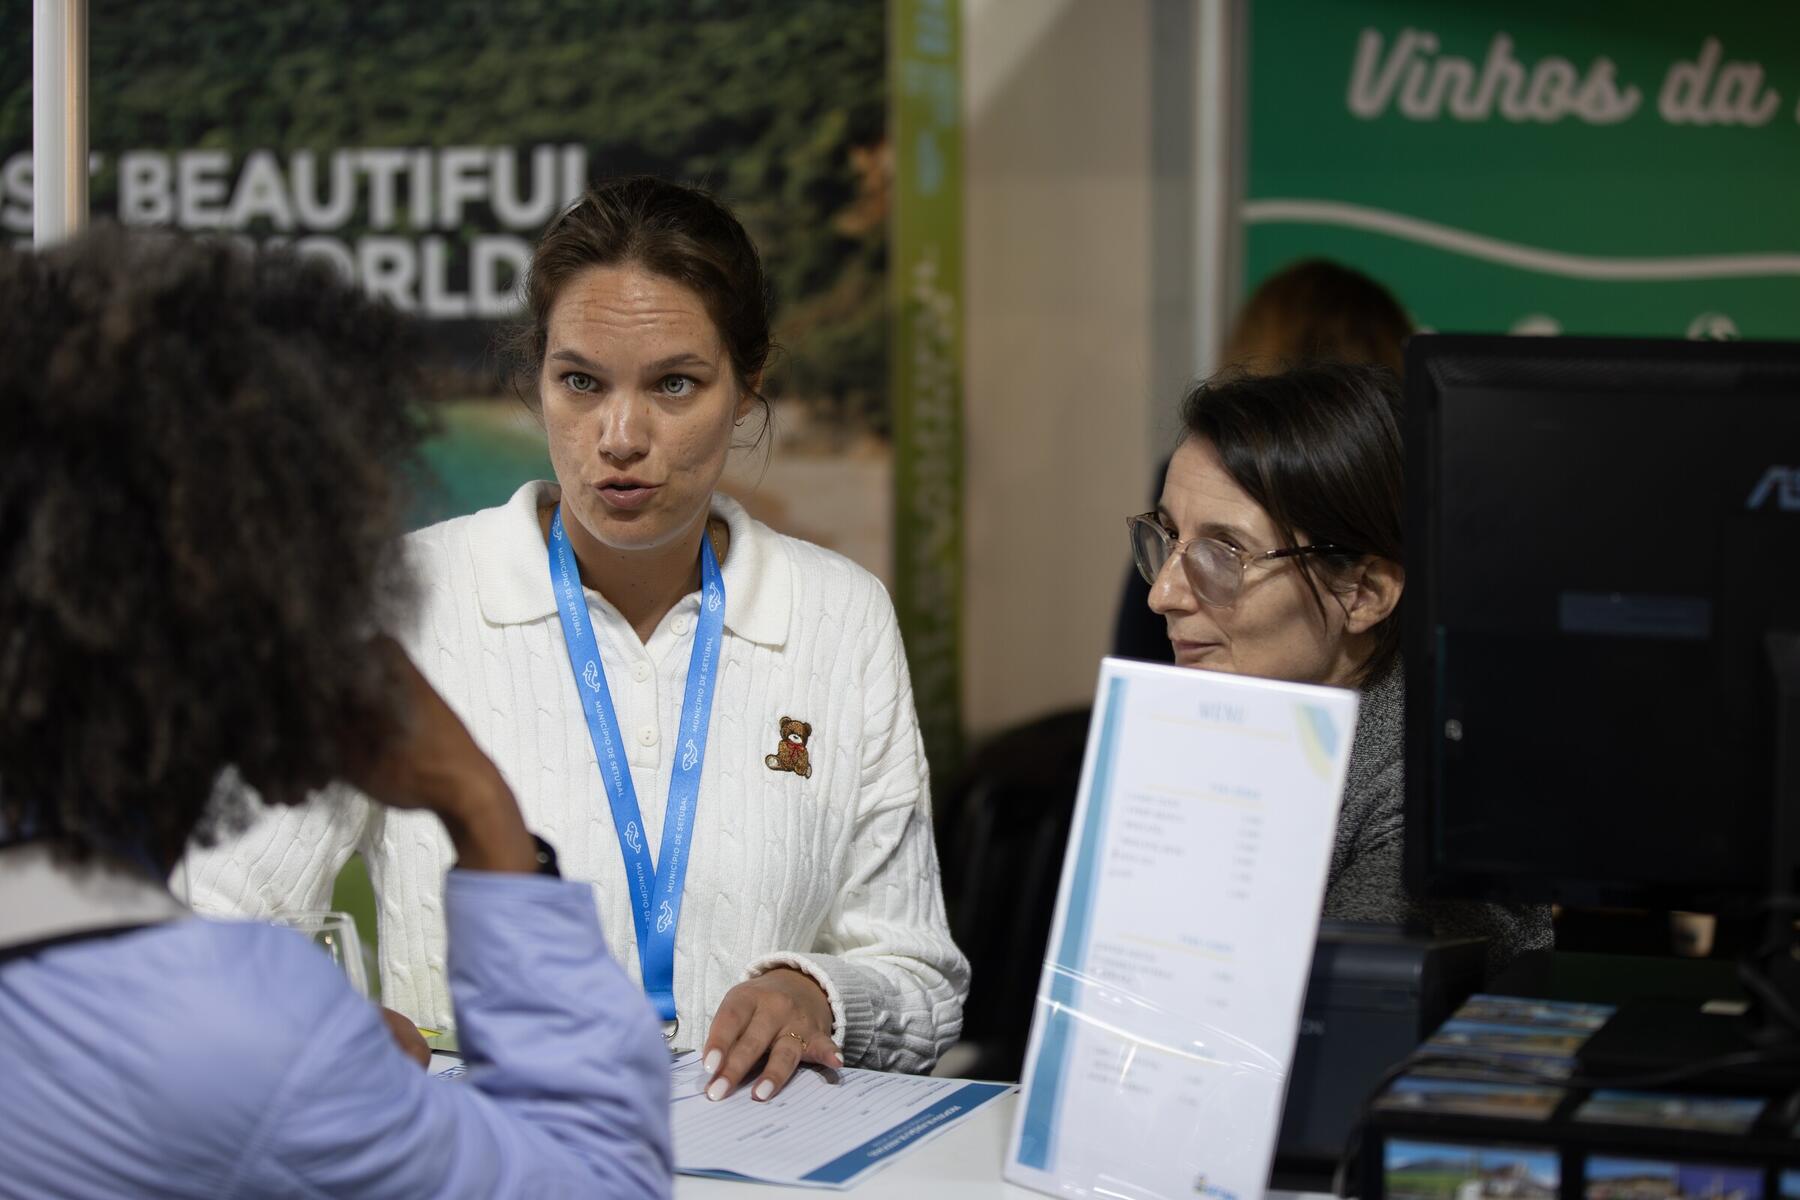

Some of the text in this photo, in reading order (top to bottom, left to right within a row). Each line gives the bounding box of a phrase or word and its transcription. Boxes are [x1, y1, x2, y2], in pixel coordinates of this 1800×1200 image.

[1348, 27, 1781, 126] Vinhos da
[200, 235, 532, 318] ORLD
[565, 588, 573, 600] DE
[699, 674, 706, 686] DE
[607, 747, 615, 759] DE
[675, 834, 682, 845] DE
